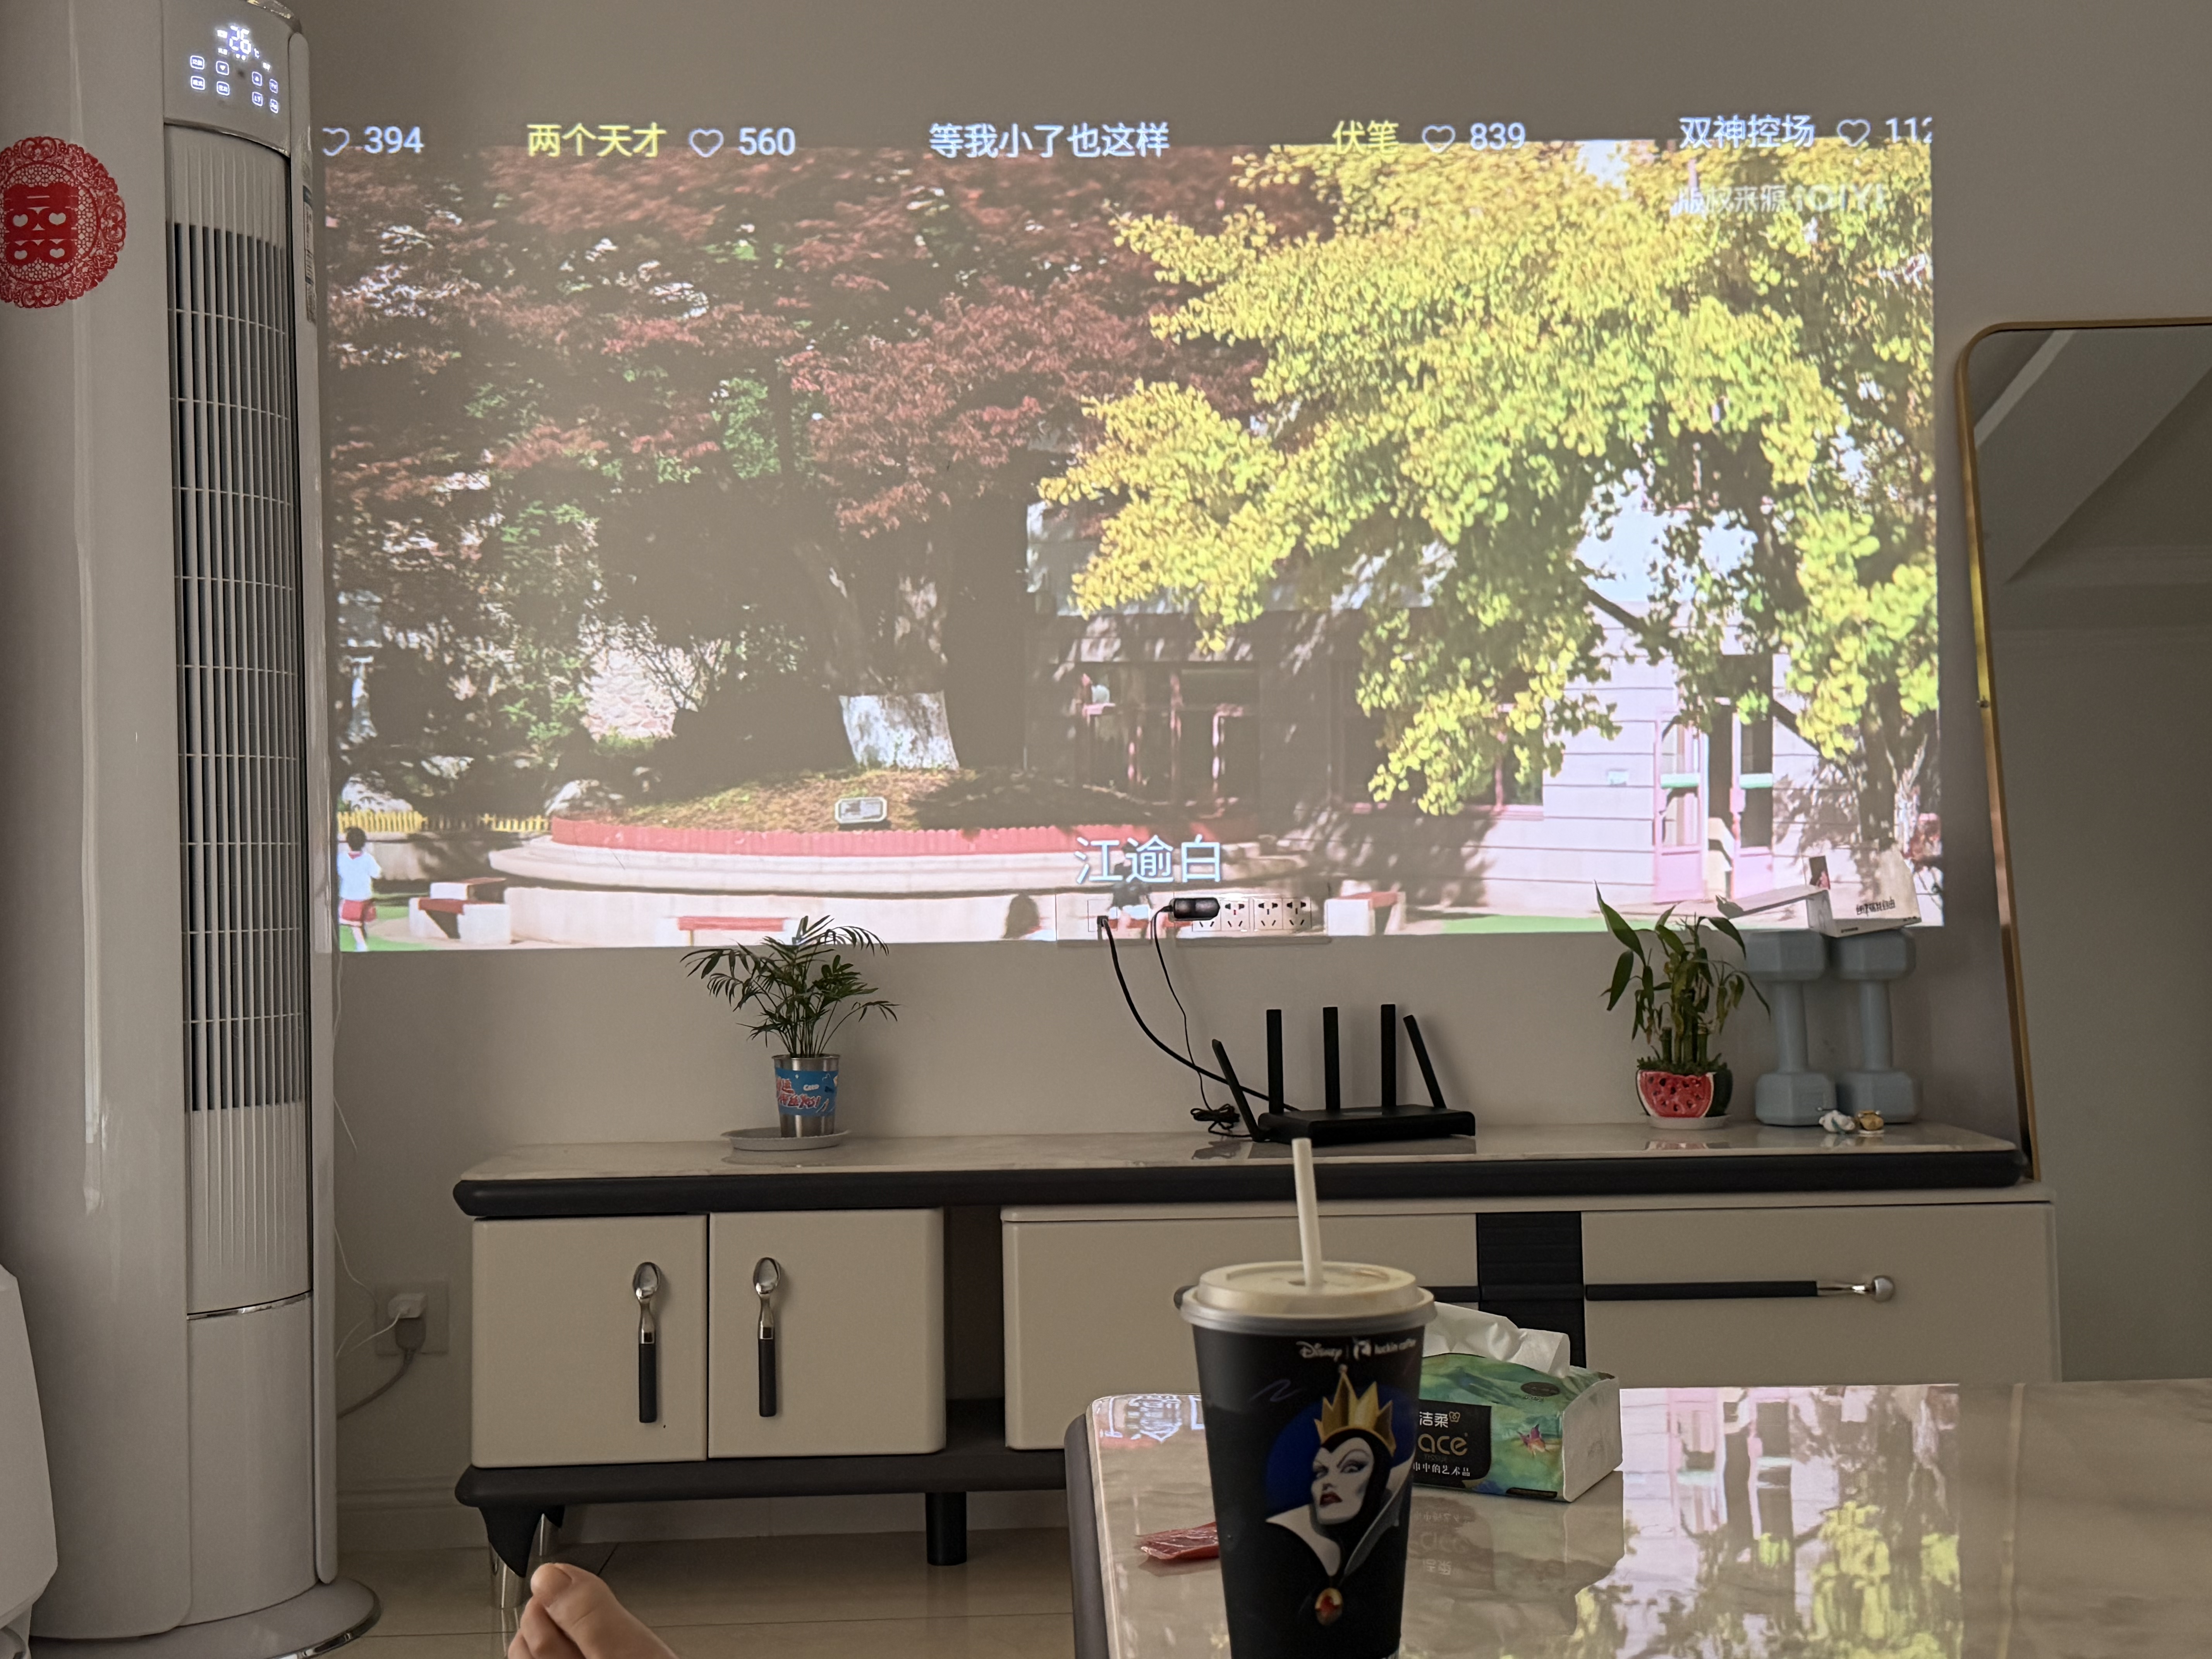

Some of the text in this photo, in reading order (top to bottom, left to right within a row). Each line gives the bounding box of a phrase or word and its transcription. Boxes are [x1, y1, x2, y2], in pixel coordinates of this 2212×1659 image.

[229, 26, 251, 54] 26
[364, 126, 424, 153] 394
[527, 122, 666, 157] 两个天才
[738, 127, 796, 156] 560
[929, 121, 1170, 158] 等我小了也这样
[1332, 120, 1399, 154] 伏笔
[1470, 122, 1526, 150] 839
[1679, 114, 1815, 149] 双神控场
[1074, 834, 1221, 884] 江逾白
[1419, 1411, 1449, 1428] 洁柔
